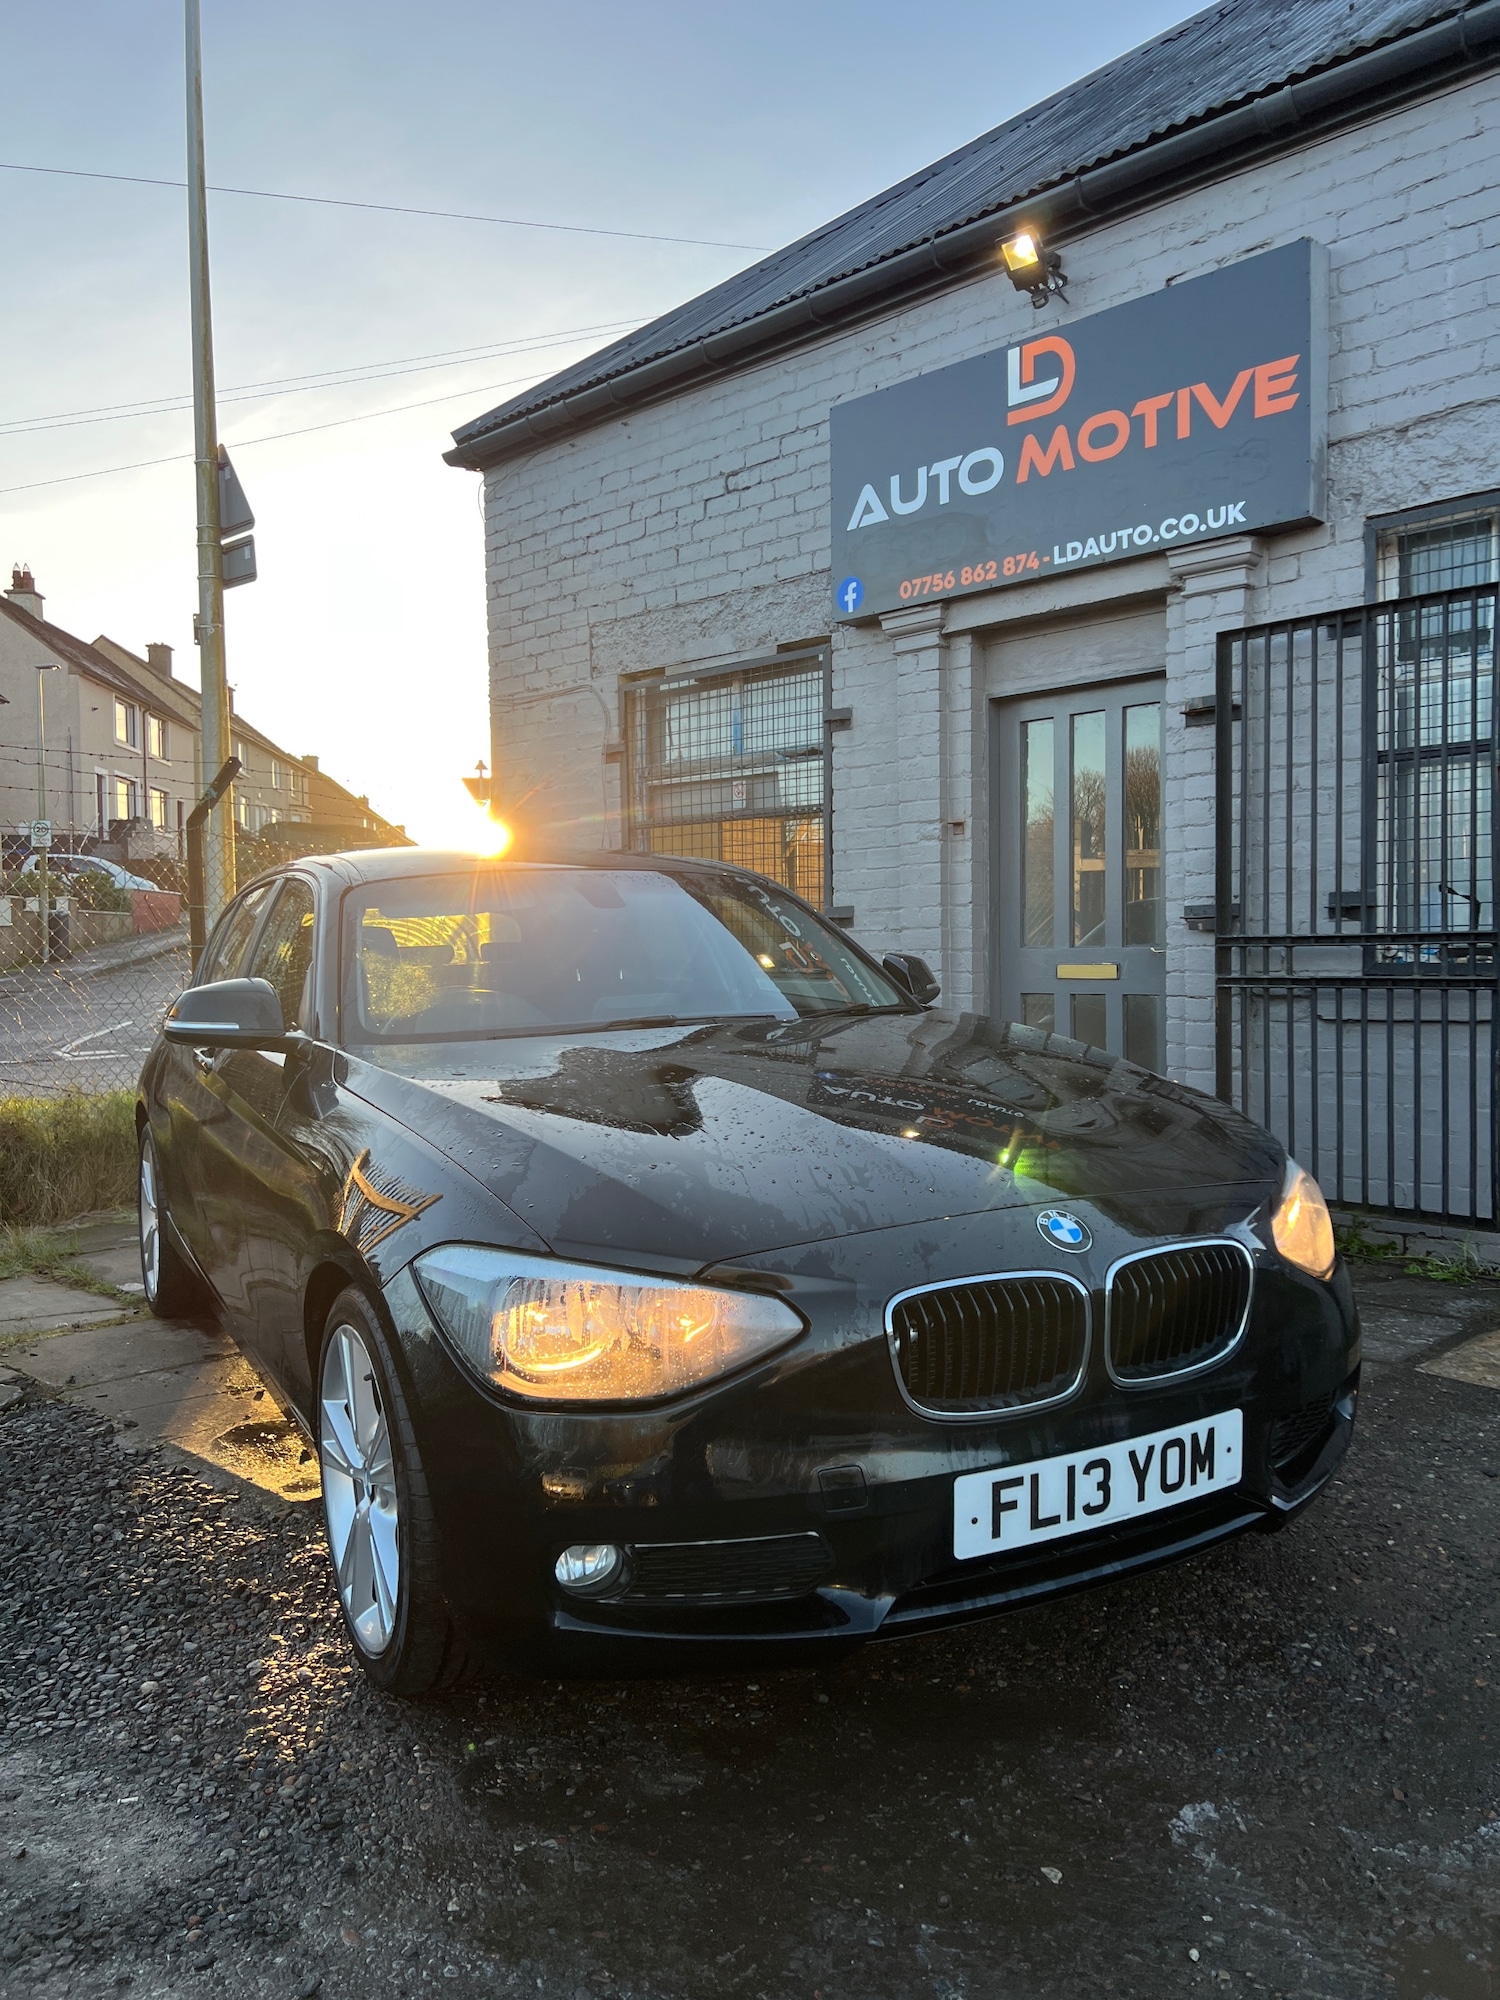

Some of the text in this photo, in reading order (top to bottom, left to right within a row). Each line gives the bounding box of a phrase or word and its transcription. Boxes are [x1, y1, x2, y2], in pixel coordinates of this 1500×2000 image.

[846, 354, 1301, 532] AUTO MOTIVE
[899, 570, 956, 599] 07756
[960, 560, 998, 586] 862
[1053, 501, 1247, 565] LDAUTO.CO.UK
[1039, 1210, 1077, 1226] BMW
[991, 1427, 1216, 1540] FL13 YOM
